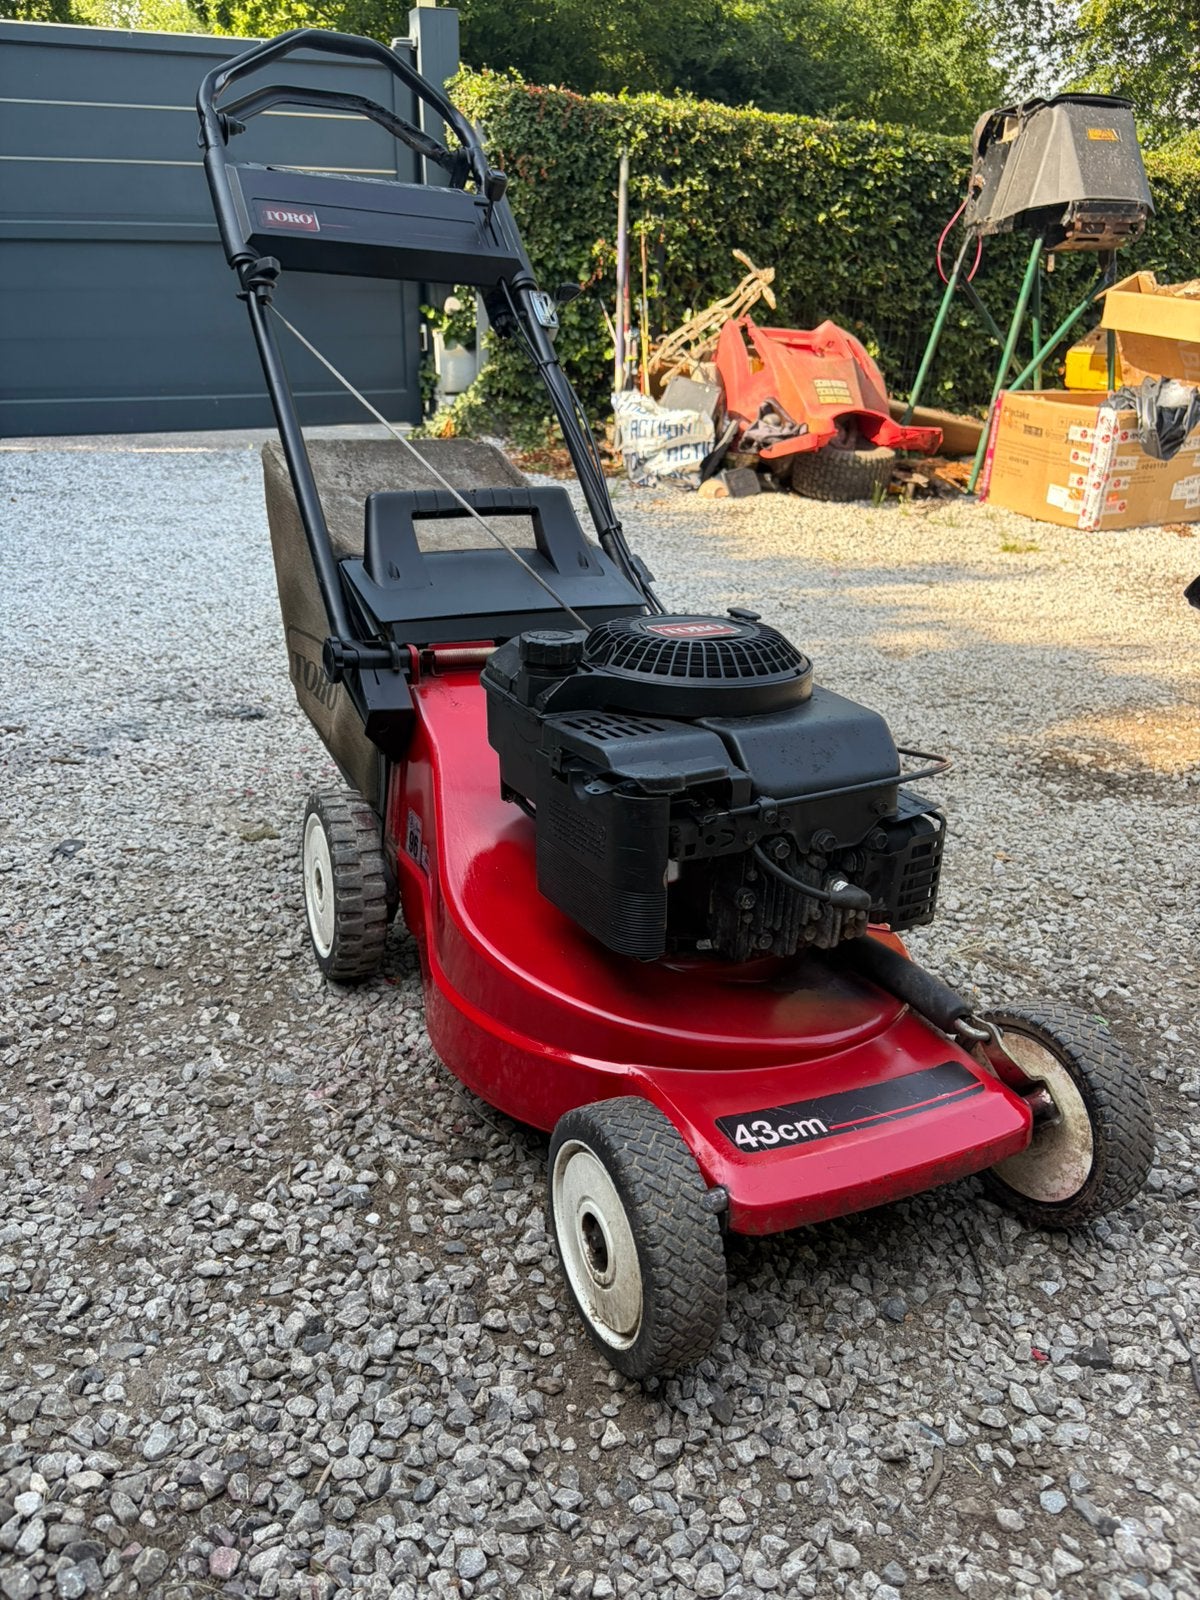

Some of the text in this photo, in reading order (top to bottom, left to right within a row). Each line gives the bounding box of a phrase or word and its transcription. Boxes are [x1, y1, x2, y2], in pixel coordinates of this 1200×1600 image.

[262, 210, 313, 225] TORO
[291, 650, 338, 711] TORO
[735, 1118, 829, 1148] 43cm
